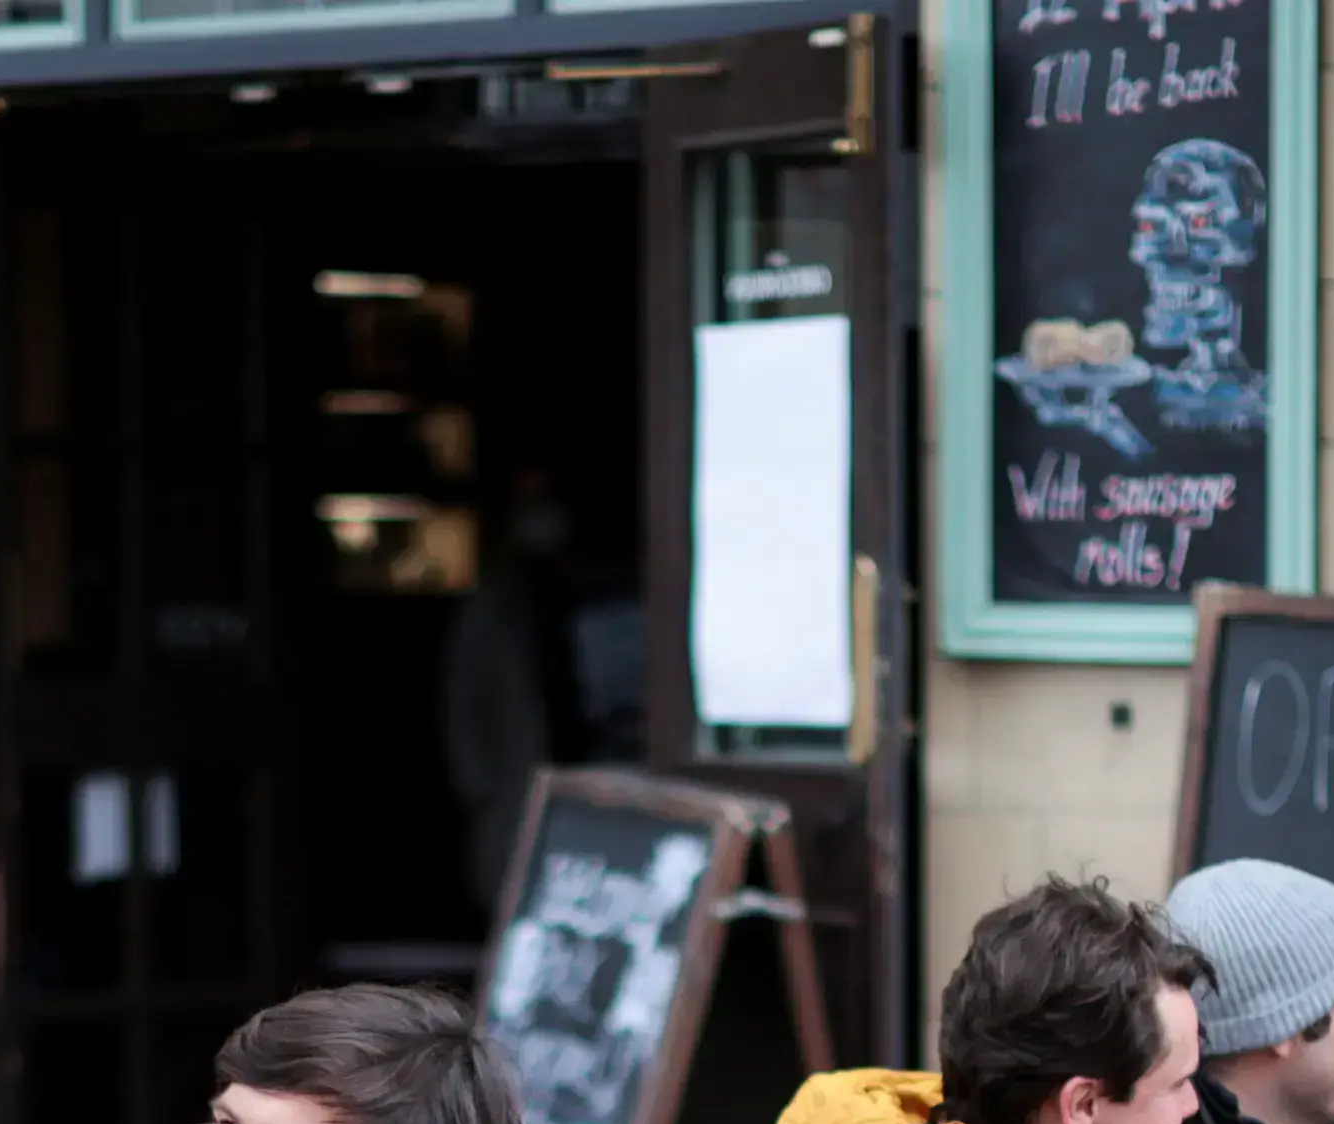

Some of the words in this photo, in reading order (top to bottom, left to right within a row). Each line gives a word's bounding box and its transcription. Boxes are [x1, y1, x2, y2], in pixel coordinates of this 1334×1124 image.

[1105, 47, 1152, 116] be
[1158, 36, 1241, 108] back
[1006, 449, 1088, 522] With
[1091, 473, 1237, 529] sausage
